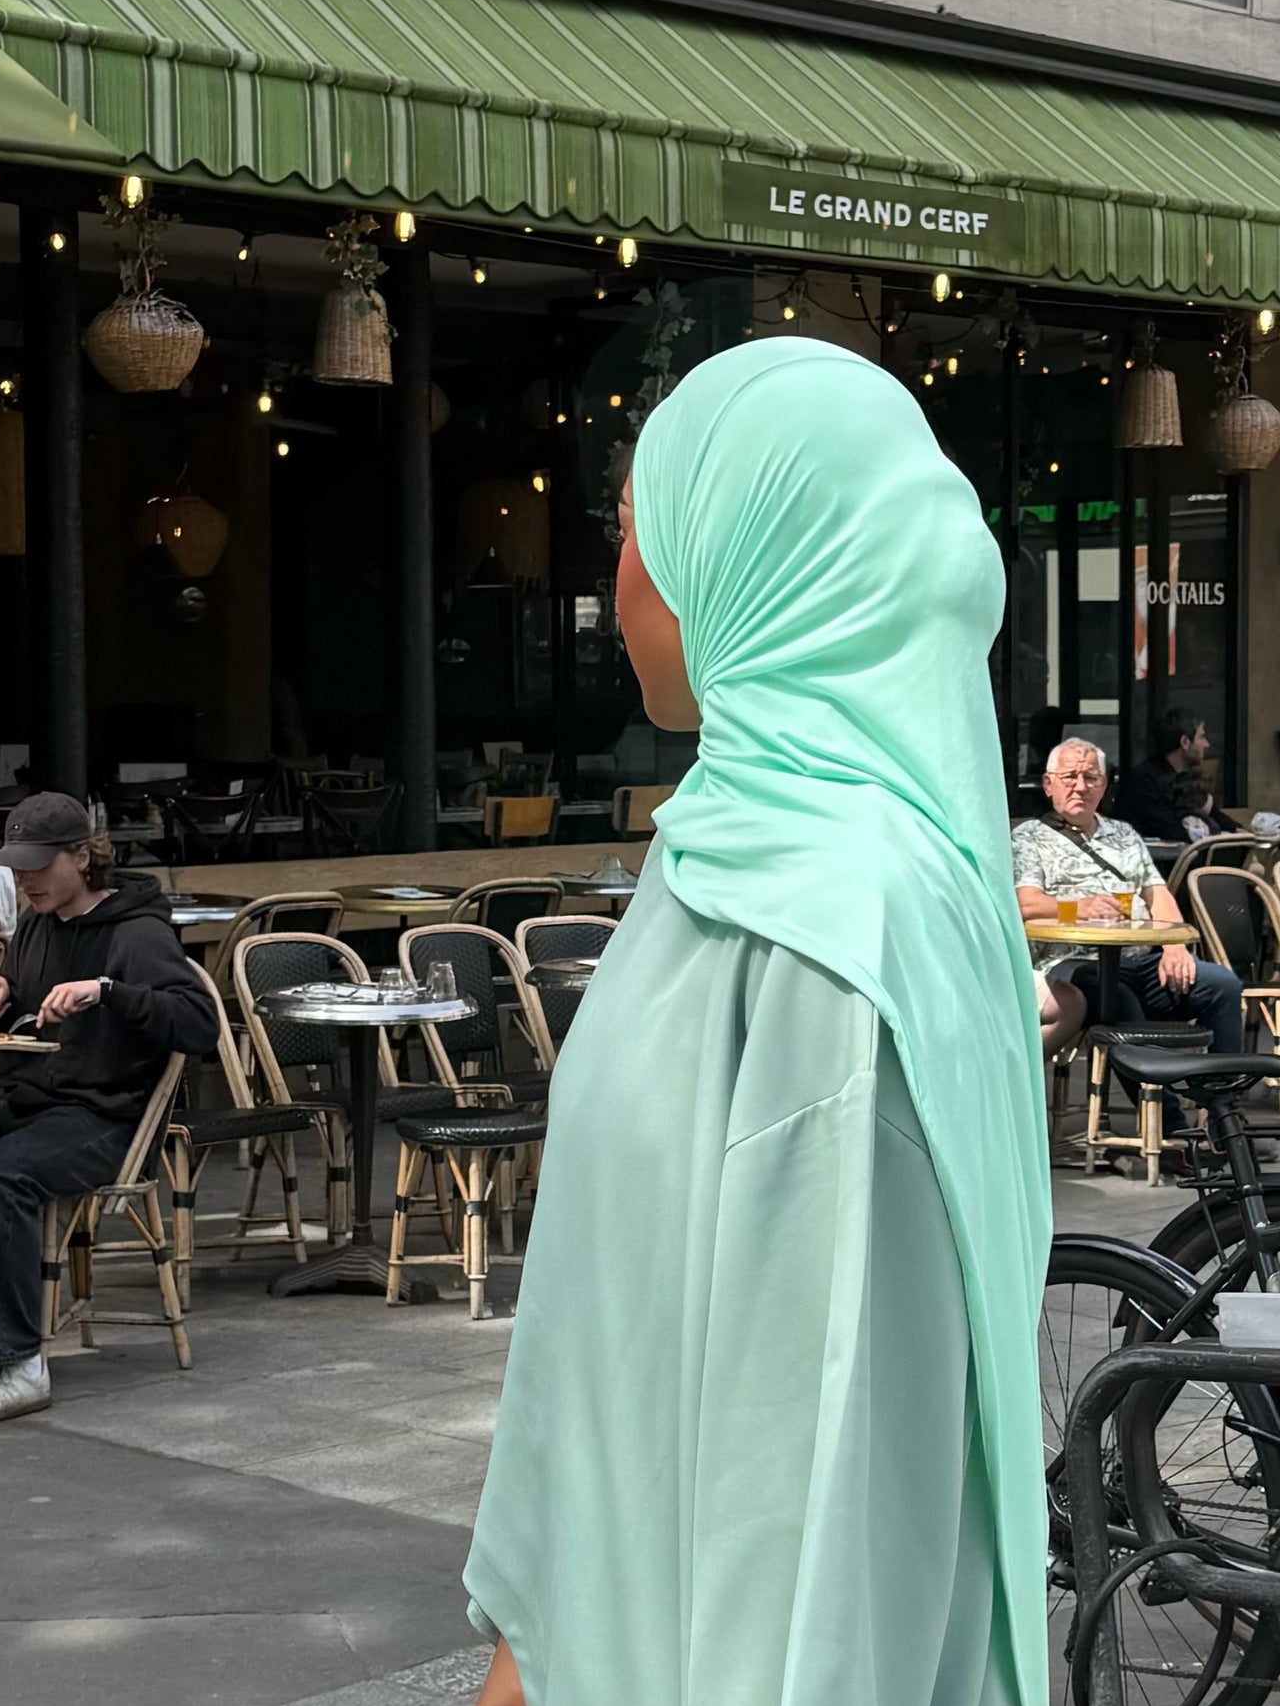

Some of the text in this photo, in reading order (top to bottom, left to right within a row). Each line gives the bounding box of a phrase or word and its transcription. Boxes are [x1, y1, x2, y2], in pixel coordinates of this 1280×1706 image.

[770, 186, 989, 236] LE GRAND CERF
[1145, 580, 1225, 606] OCKTAILS
